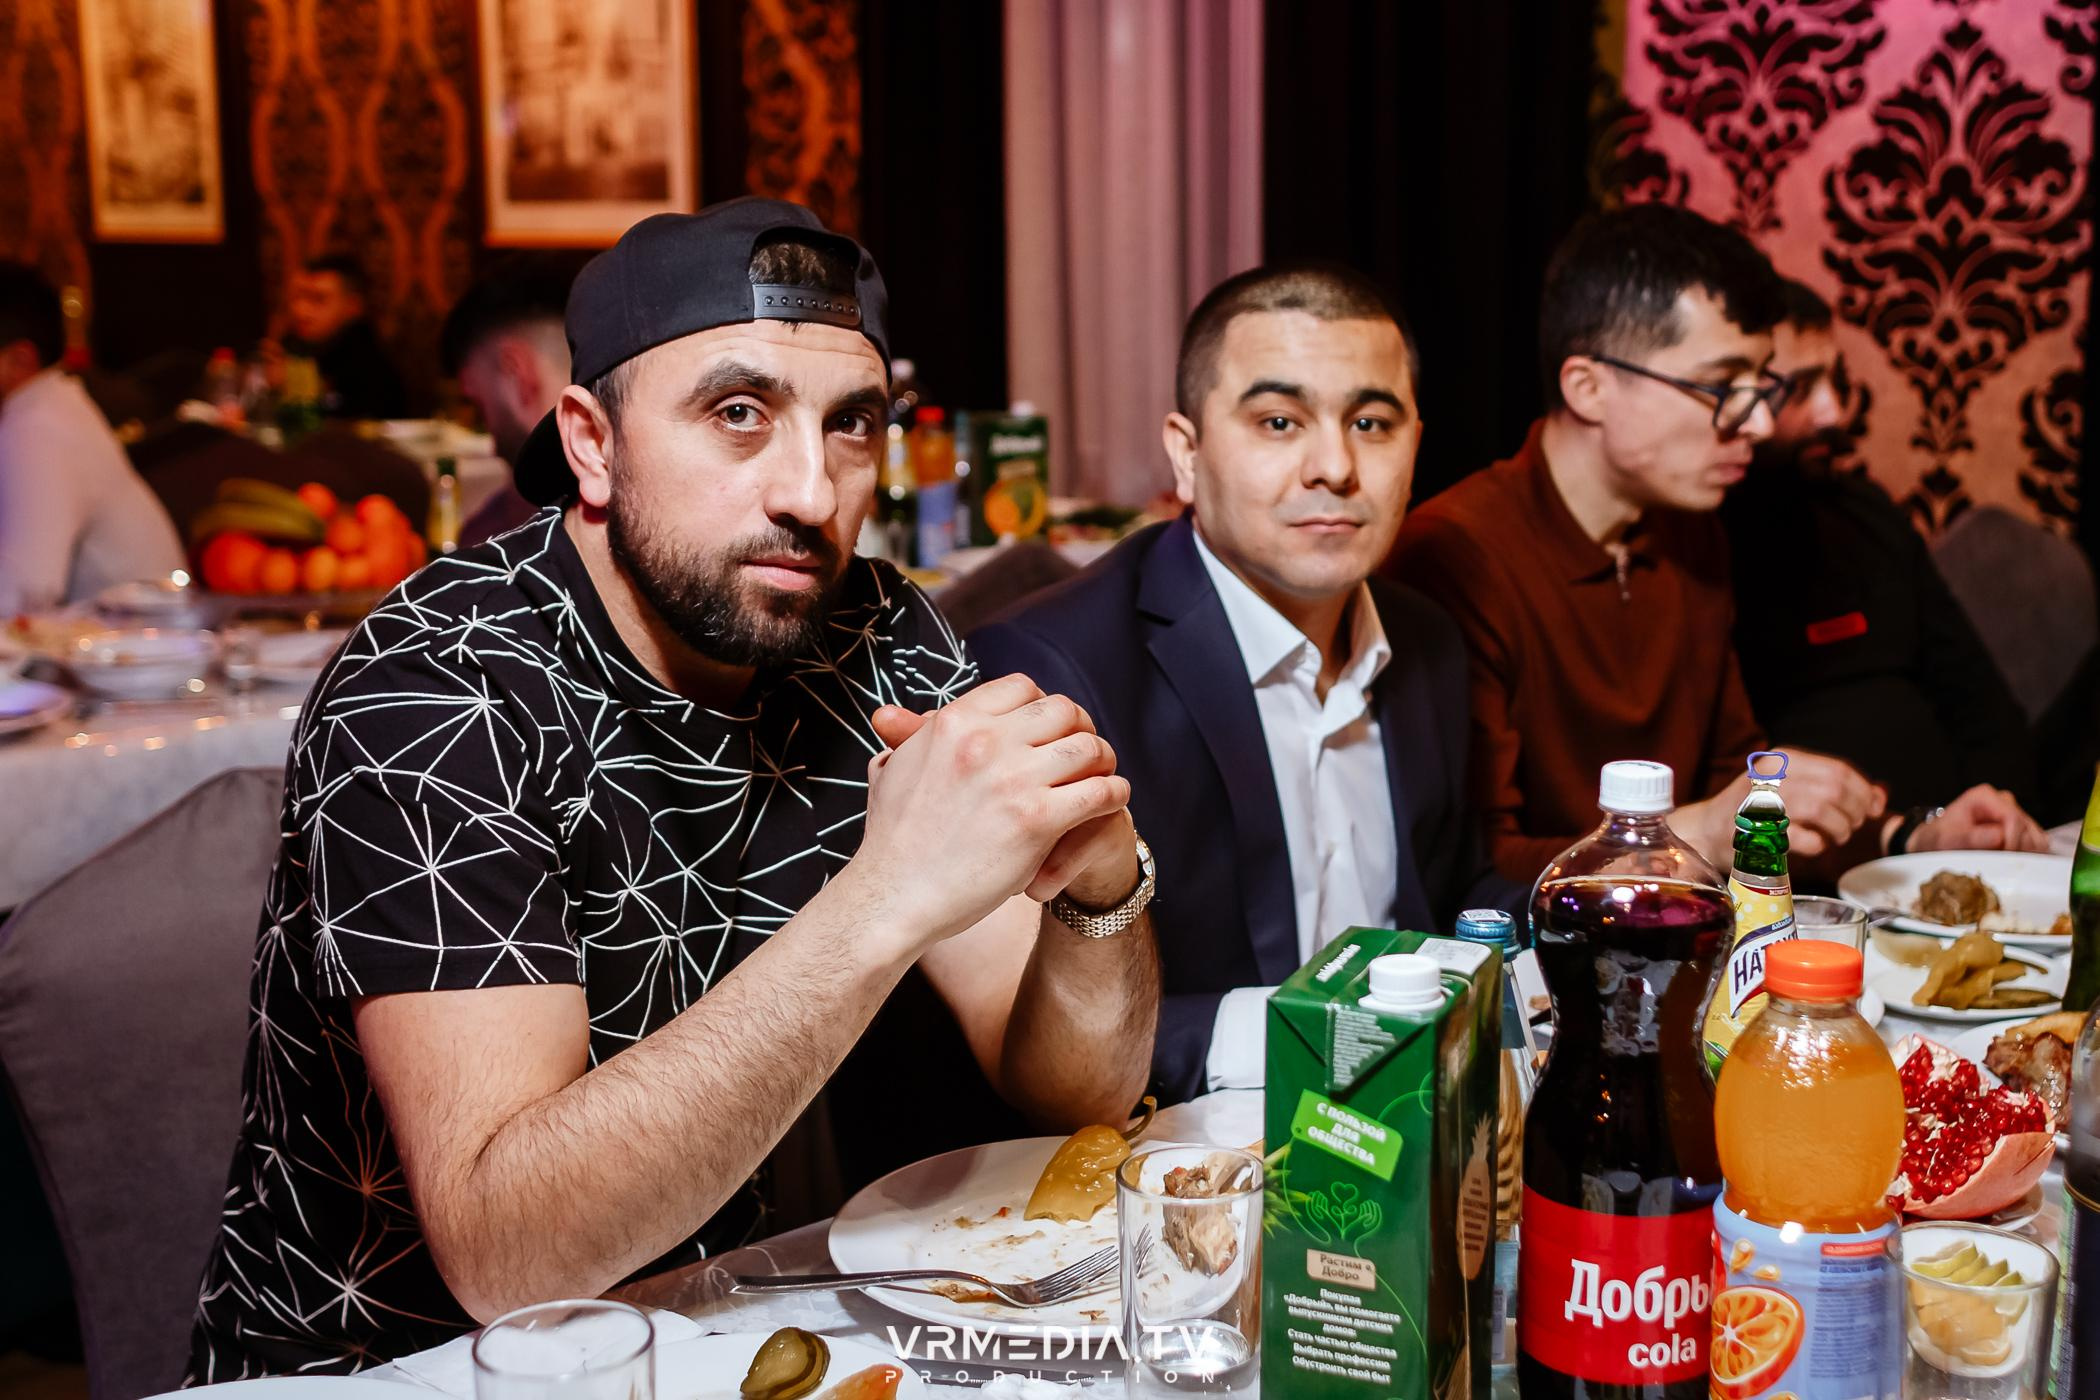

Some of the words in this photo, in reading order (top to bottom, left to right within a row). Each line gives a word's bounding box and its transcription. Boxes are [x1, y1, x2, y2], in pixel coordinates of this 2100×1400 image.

[1316, 1102, 1328, 1116] С
[1327, 1105, 1387, 1144] ПОЛЬЗОЙ
[1331, 1122, 1360, 1145] ДЛЯ
[1308, 1126, 1375, 1167] ОБЩЕСТВА
[1320, 1253, 1362, 1270] Растим
[1322, 1265, 1360, 1280] Добро
[1320, 1288, 1362, 1306] Покупая
[1564, 1258, 1710, 1329] Добры
[1288, 1305, 1353, 1326] выпускникам
[1353, 1318, 1394, 1335] детских
[1334, 1303, 1348, 1315] вы
[1349, 1306, 1401, 1324] помогаете
[1288, 1328, 1314, 1342] Стать
[1314, 1334, 1349, 1350] частью
[1349, 1341, 1397, 1359] общества
[1293, 1342, 1334, 1360] Выбрать
[1334, 1352, 1391, 1371] профессию
[1628, 1333, 1697, 1369] cola
[1292, 1355, 1347, 1376] Обустроить
[1347, 1368, 1370, 1380] свой
[1371, 1370, 1391, 1385] быт
